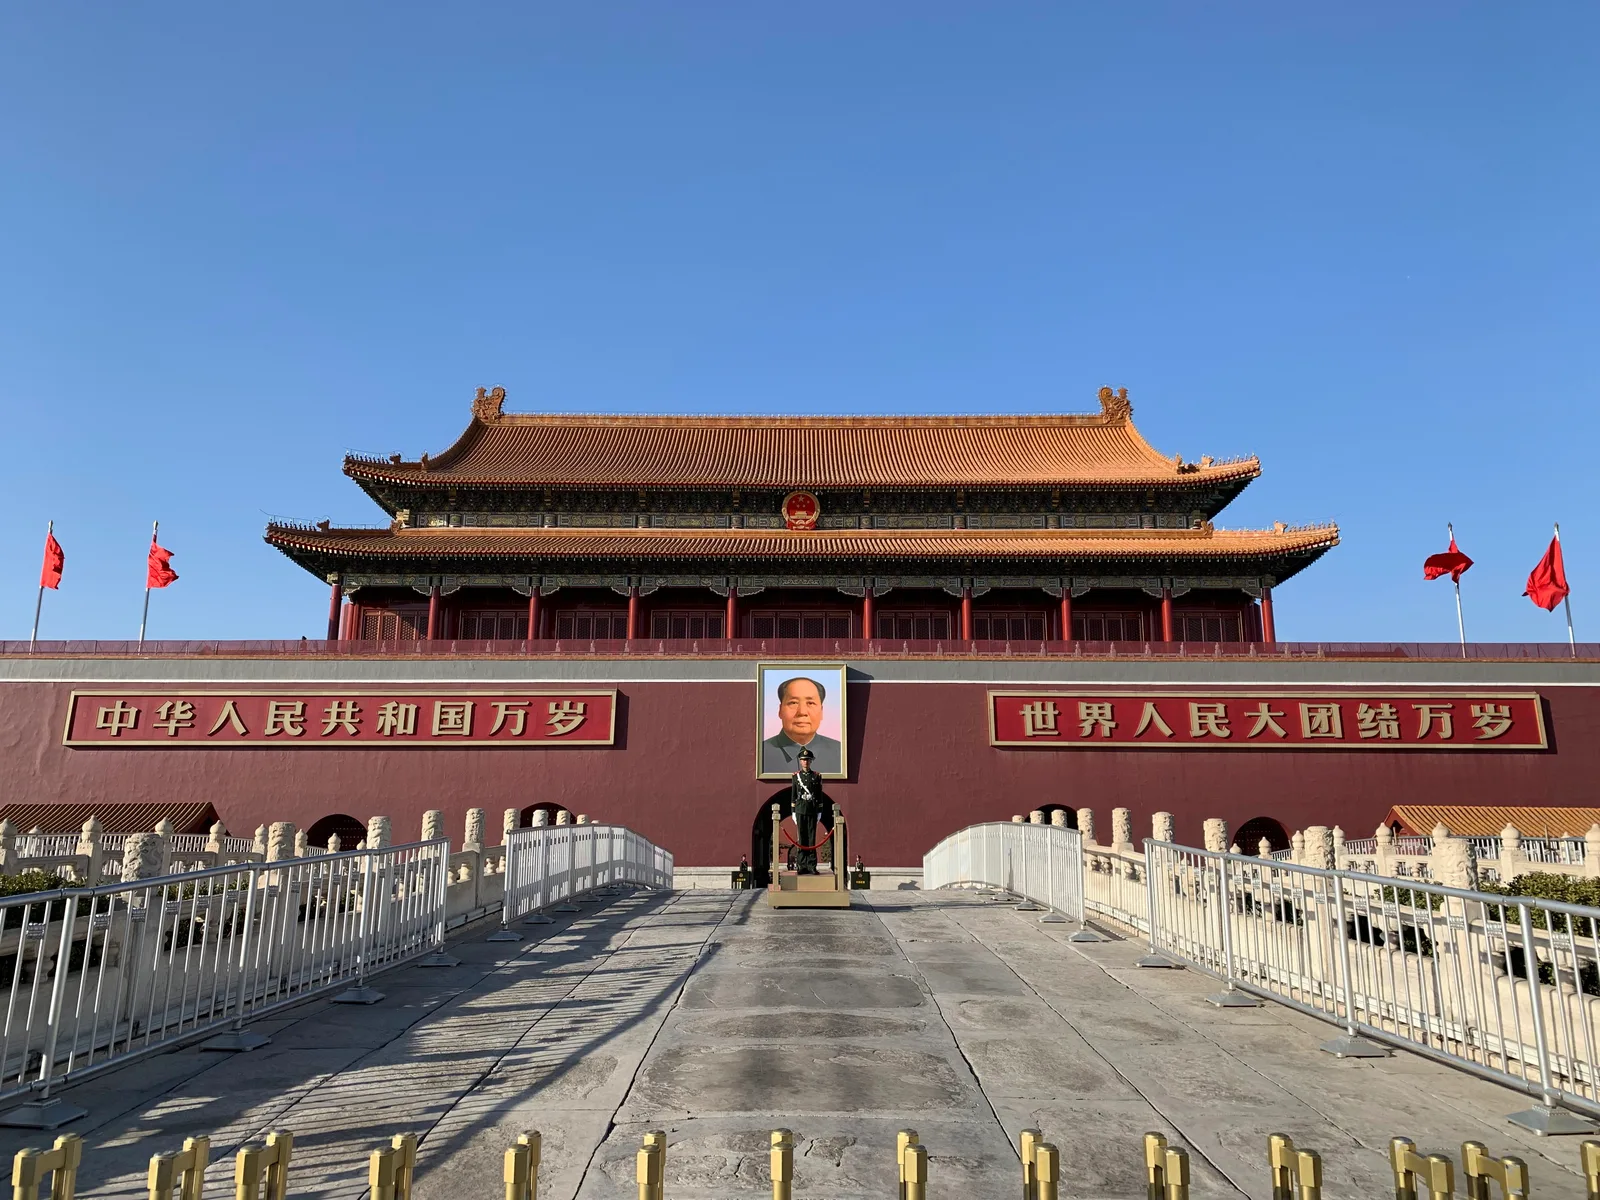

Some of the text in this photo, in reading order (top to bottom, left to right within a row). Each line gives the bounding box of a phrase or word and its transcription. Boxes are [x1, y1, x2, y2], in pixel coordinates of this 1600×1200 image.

[94, 700, 587, 736] 中华人民共和国万岁
[1019, 702, 1513, 738] 世界人民大团结万岁
